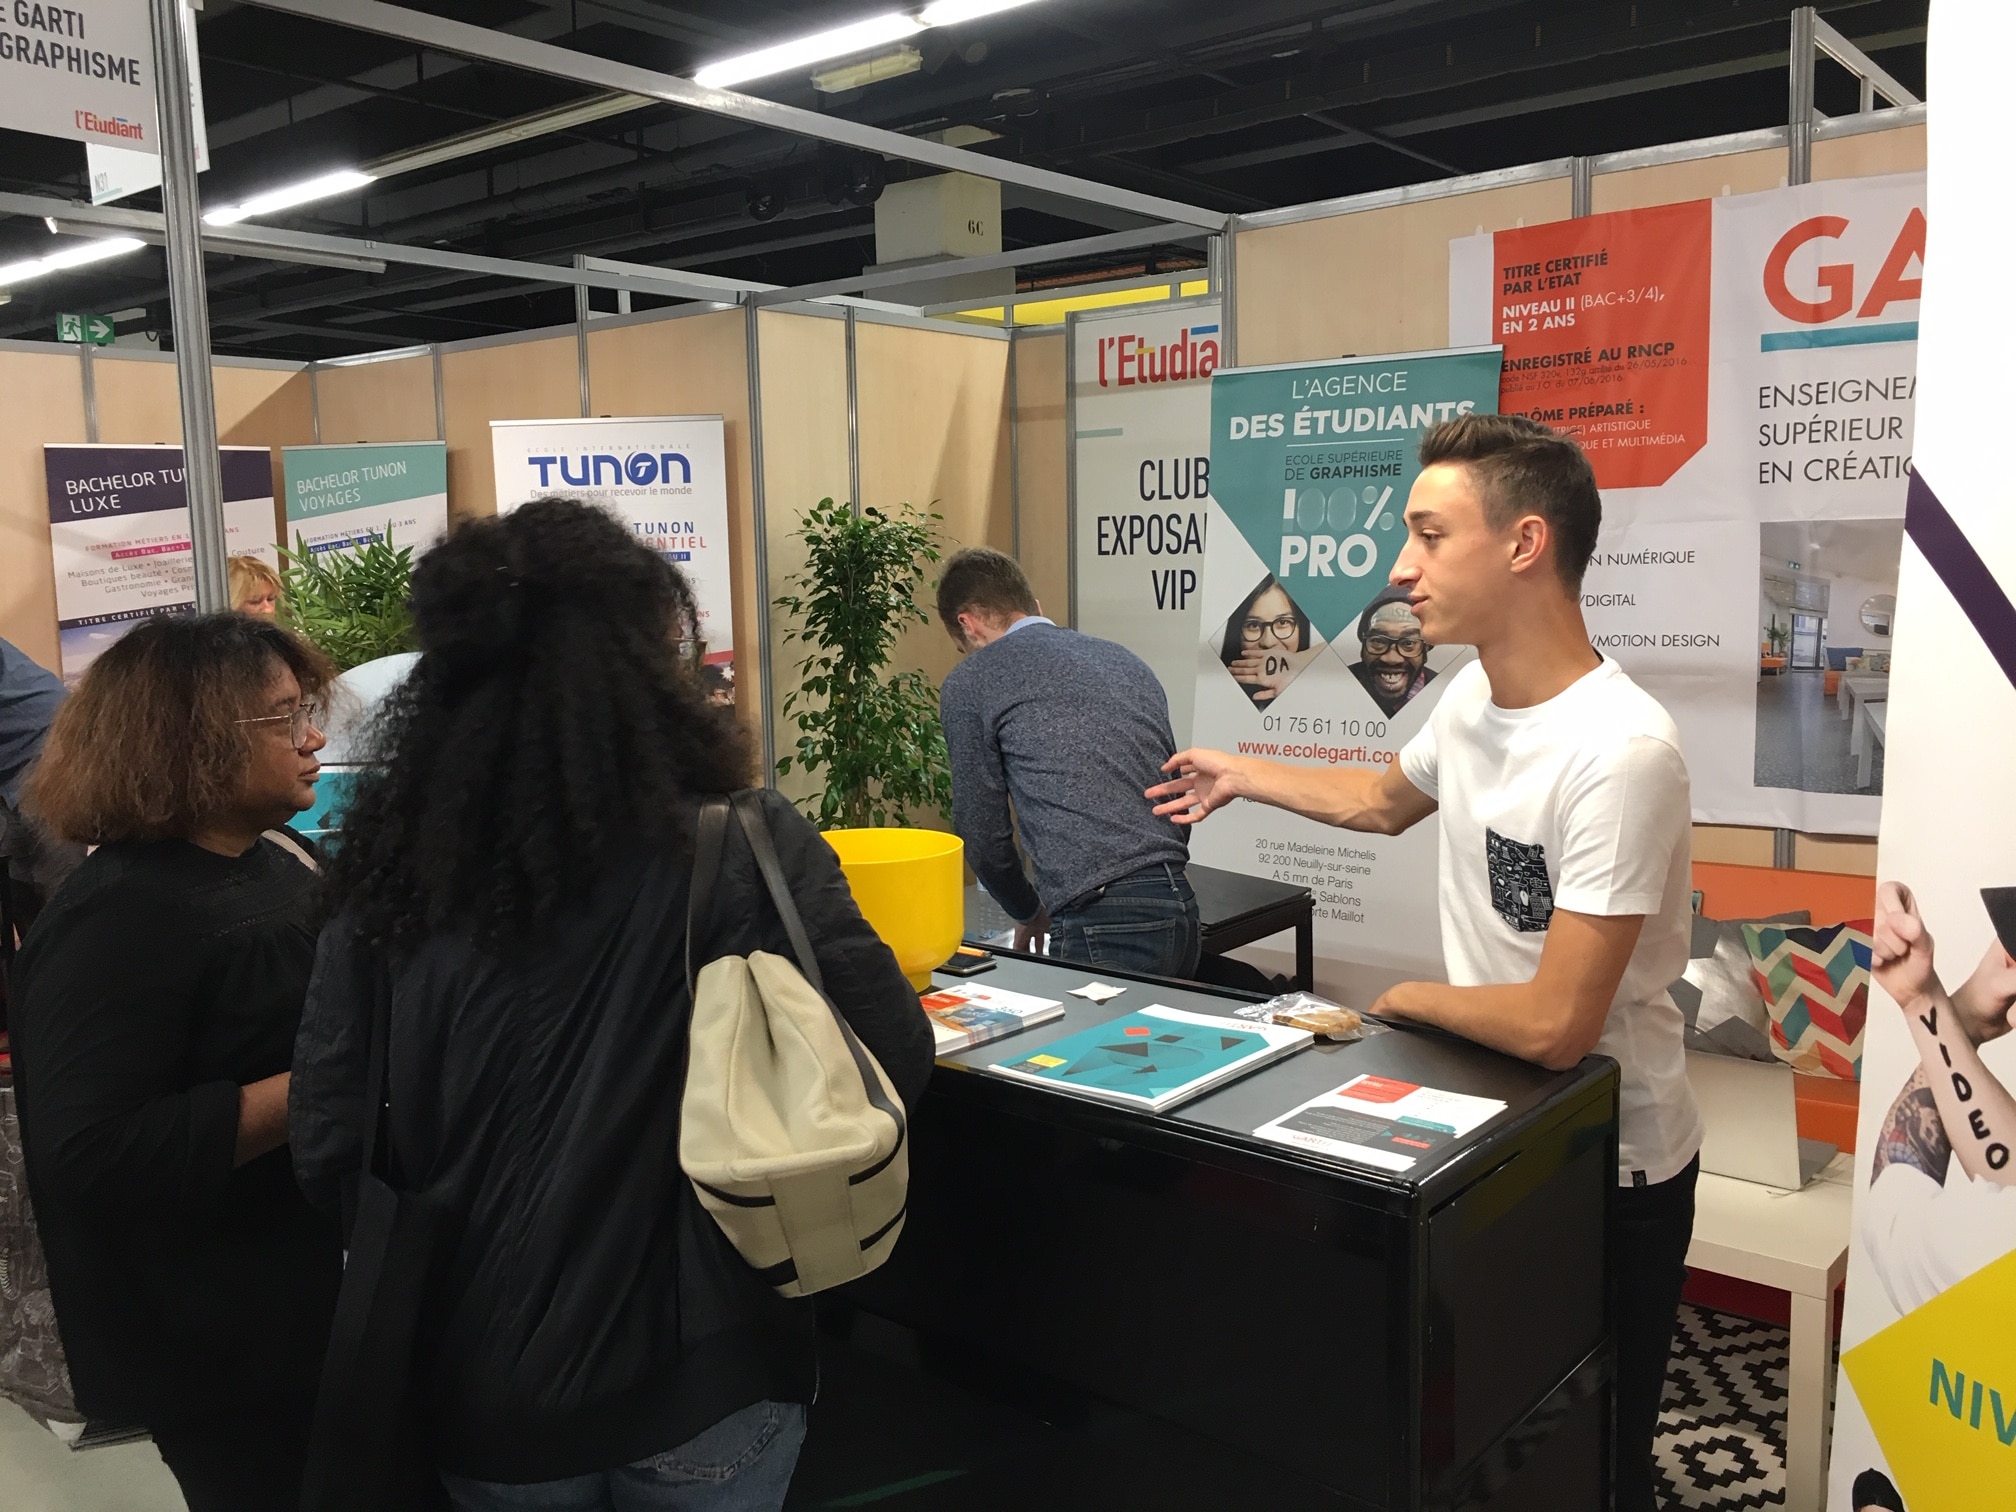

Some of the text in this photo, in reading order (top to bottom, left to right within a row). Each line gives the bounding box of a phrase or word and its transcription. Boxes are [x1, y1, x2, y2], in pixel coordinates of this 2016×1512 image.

[14, 0, 84, 39] GARTI
[0, 32, 141, 86] GRAPHISME
[967, 219, 984, 236] 6C
[1503, 248, 1608, 280] TITRE CERTIFIÉ
[1503, 272, 1582, 296] PAR L'ETAT
[1502, 298, 1561, 319] NIVEAU
[1566, 296, 1575, 310] II
[1502, 312, 1576, 335] EN 2 ANS
[1501, 342, 1675, 373] ENREGISTRÉ AU RNCP
[1292, 371, 1409, 399] L'AGENCE
[1759, 376, 1917, 409] ENSEIGNE
[1568, 399, 1634, 419] PRÉPARÉ
[1229, 413, 1285, 440] DES
[1589, 419, 1651, 433] ARTISTIQUE
[1758, 414, 1903, 447] SUPÉRIEUR
[1602, 437, 1614, 449] ET
[1617, 433, 1686, 448] MULTIMÉDIA
[1285, 452, 1324, 466] ECOLE
[65, 467, 187, 495] BACHELOR TU
[297, 460, 407, 495] BACHELOR TUNON
[1139, 456, 1210, 501] CLUB
[1284, 463, 1403, 481] DE GRAPHISME
[1759, 460, 1792, 484] EN
[70, 494, 122, 514] LUXE
[299, 487, 361, 512] VOYAGES
[530, 489, 548, 499] Des
[610, 486, 647, 497] recevoir
[650, 486, 657, 496] le
[660, 486, 693, 496] monde
[633, 521, 694, 535] TUNON
[1097, 512, 1207, 556] EXPOSA
[85, 540, 132, 552] FORMATION
[135, 535, 169, 545] MÉTIERS
[637, 536, 707, 550] ENTIEL
[1279, 533, 1378, 578] PRO
[1607, 548, 1696, 566] NUMÉRIQUE
[68, 568, 105, 579] Maisons
[108, 565, 120, 573] de
[122, 561, 144, 572] Luxe
[81, 575, 127, 588] Boutiques
[130, 568, 162, 581] beauté
[104, 579, 161, 594] Gastronomie
[140, 586, 179, 598] Voyages
[1151, 569, 1197, 610] VIP
[78, 615, 106, 625] TITRE
[160, 605, 178, 615] PAR
[1661, 634, 1720, 647] DESIGN
[1263, 715, 1386, 738] 01 75 61 10 00
[1238, 741, 1398, 764] www.ecolegarti.co
[1255, 838, 1376, 861] 20 rue Madeleine Michelis
[1258, 853, 1371, 875] 92 200 Neuilly-sur-seine
[1272, 870, 1353, 890] A 5 mn de Paris
[1319, 891, 1361, 907] Sablons
[1331, 908, 1364, 923] Maillot
[1919, 1005, 2009, 1171] VIDEO
[1929, 1357, 2016, 1447] NIV
